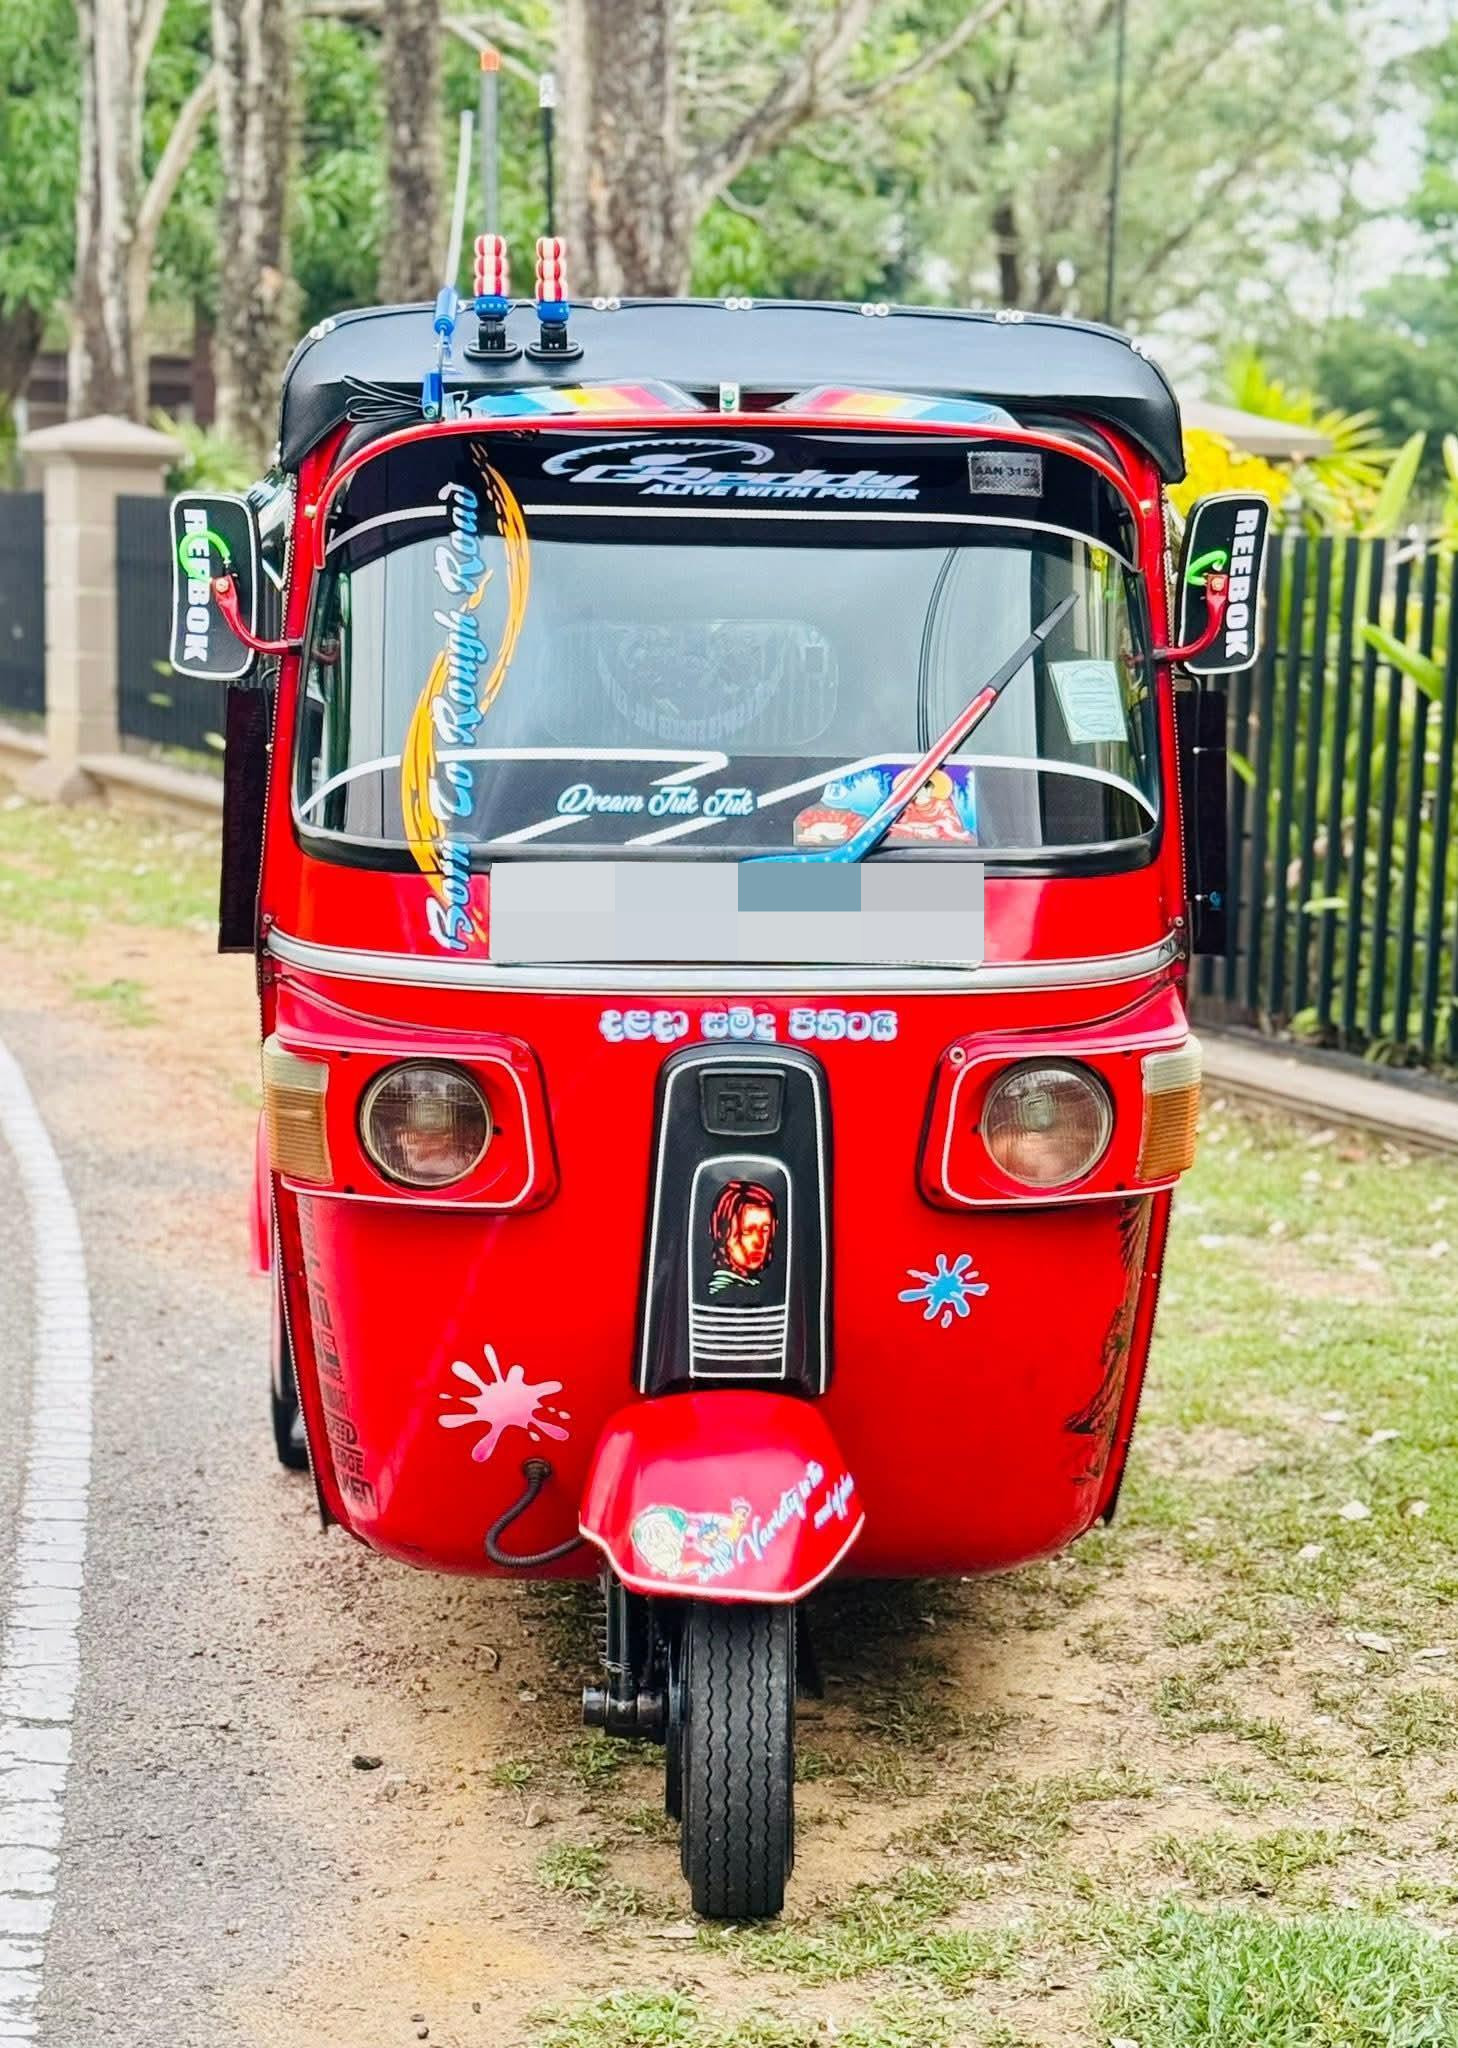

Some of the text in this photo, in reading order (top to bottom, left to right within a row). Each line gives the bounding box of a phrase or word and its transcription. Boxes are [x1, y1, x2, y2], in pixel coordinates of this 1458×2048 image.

[976, 466, 1003, 476] AAN
[638, 484, 920, 500] ALIVE WITH POWER
[1225, 508, 1261, 660] REEBOK
[425, 481, 489, 952] Born To Rough Road
[556, 783, 755, 818] Dream Tuk Tuk
